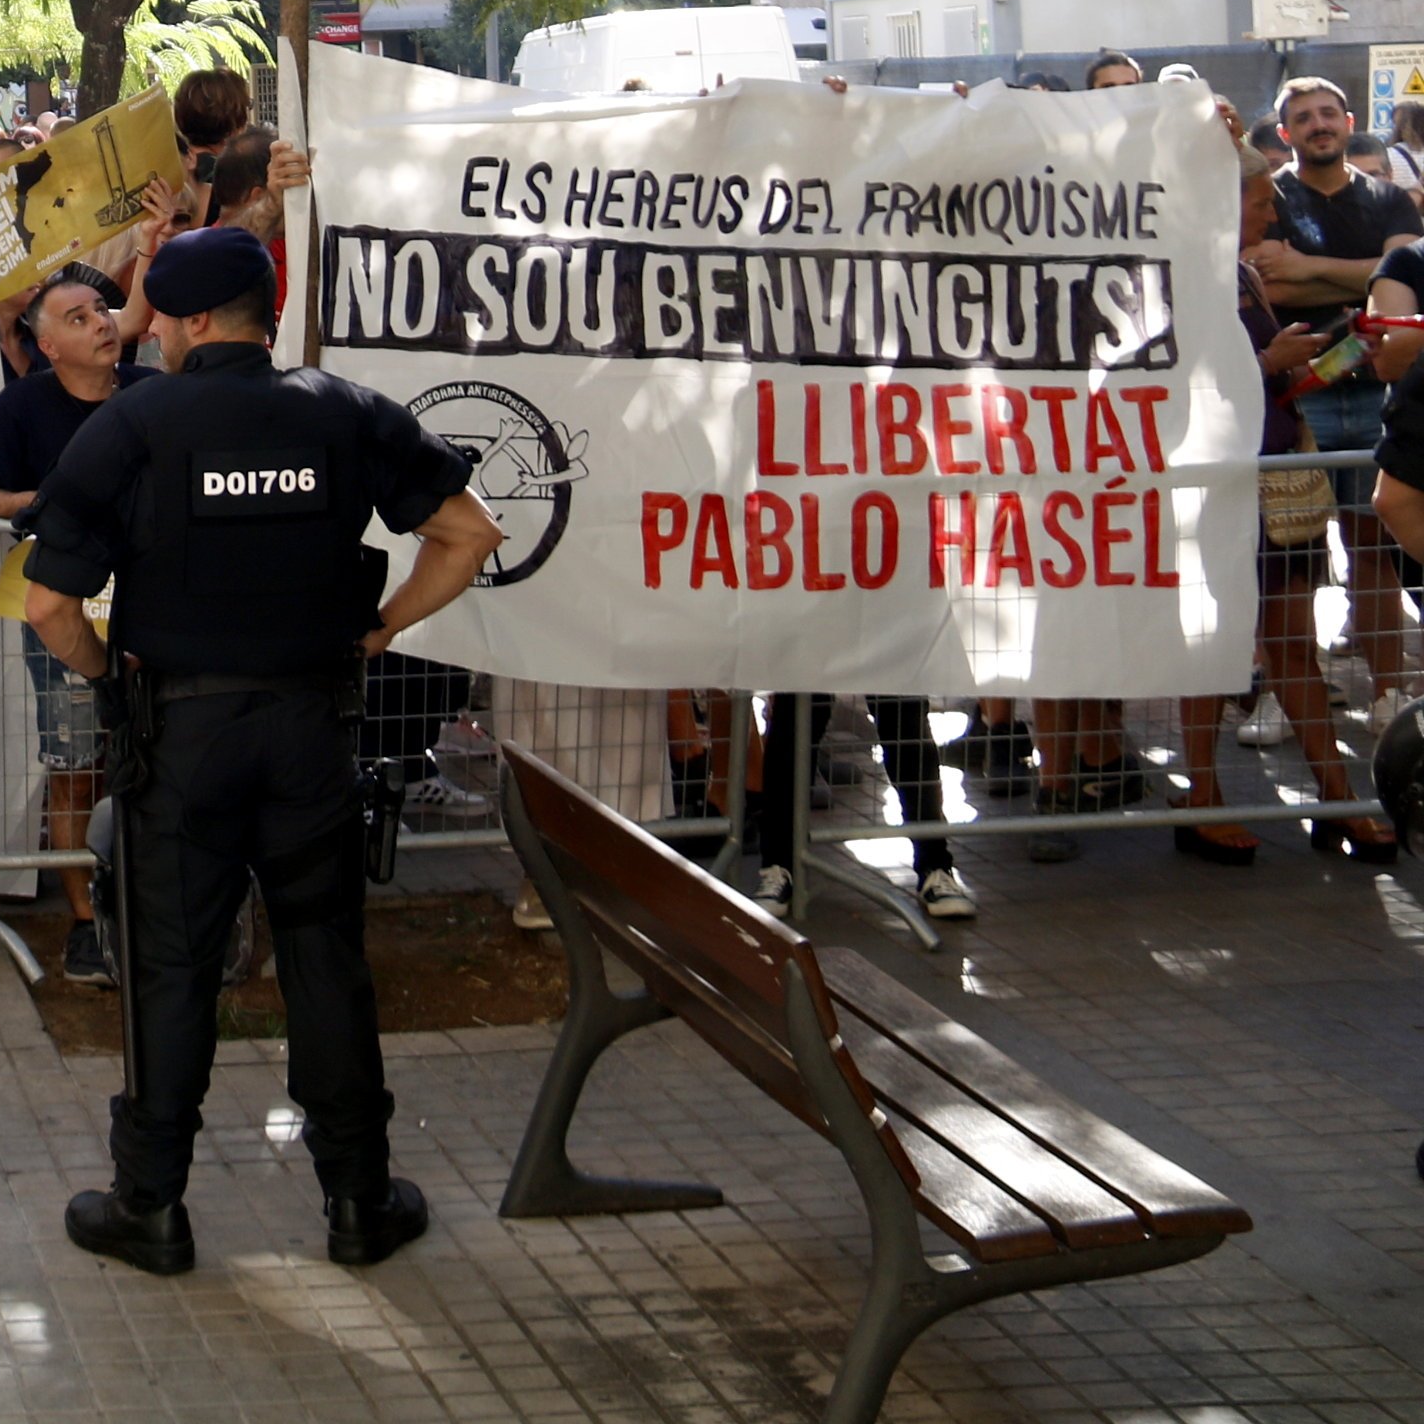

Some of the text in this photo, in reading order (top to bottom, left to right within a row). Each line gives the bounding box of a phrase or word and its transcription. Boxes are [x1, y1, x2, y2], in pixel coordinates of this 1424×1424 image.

[462, 156, 551, 224] ELS
[564, 167, 750, 233] HEREUS
[758, 177, 843, 236] DEL
[331, 236, 1174, 366] NO SOU BENVINGUTS!
[409, 383, 466, 416] ATAFORMA
[756, 379, 1170, 477] LLIBERTAT
[641, 477, 1180, 592] PABLO HASÉL
